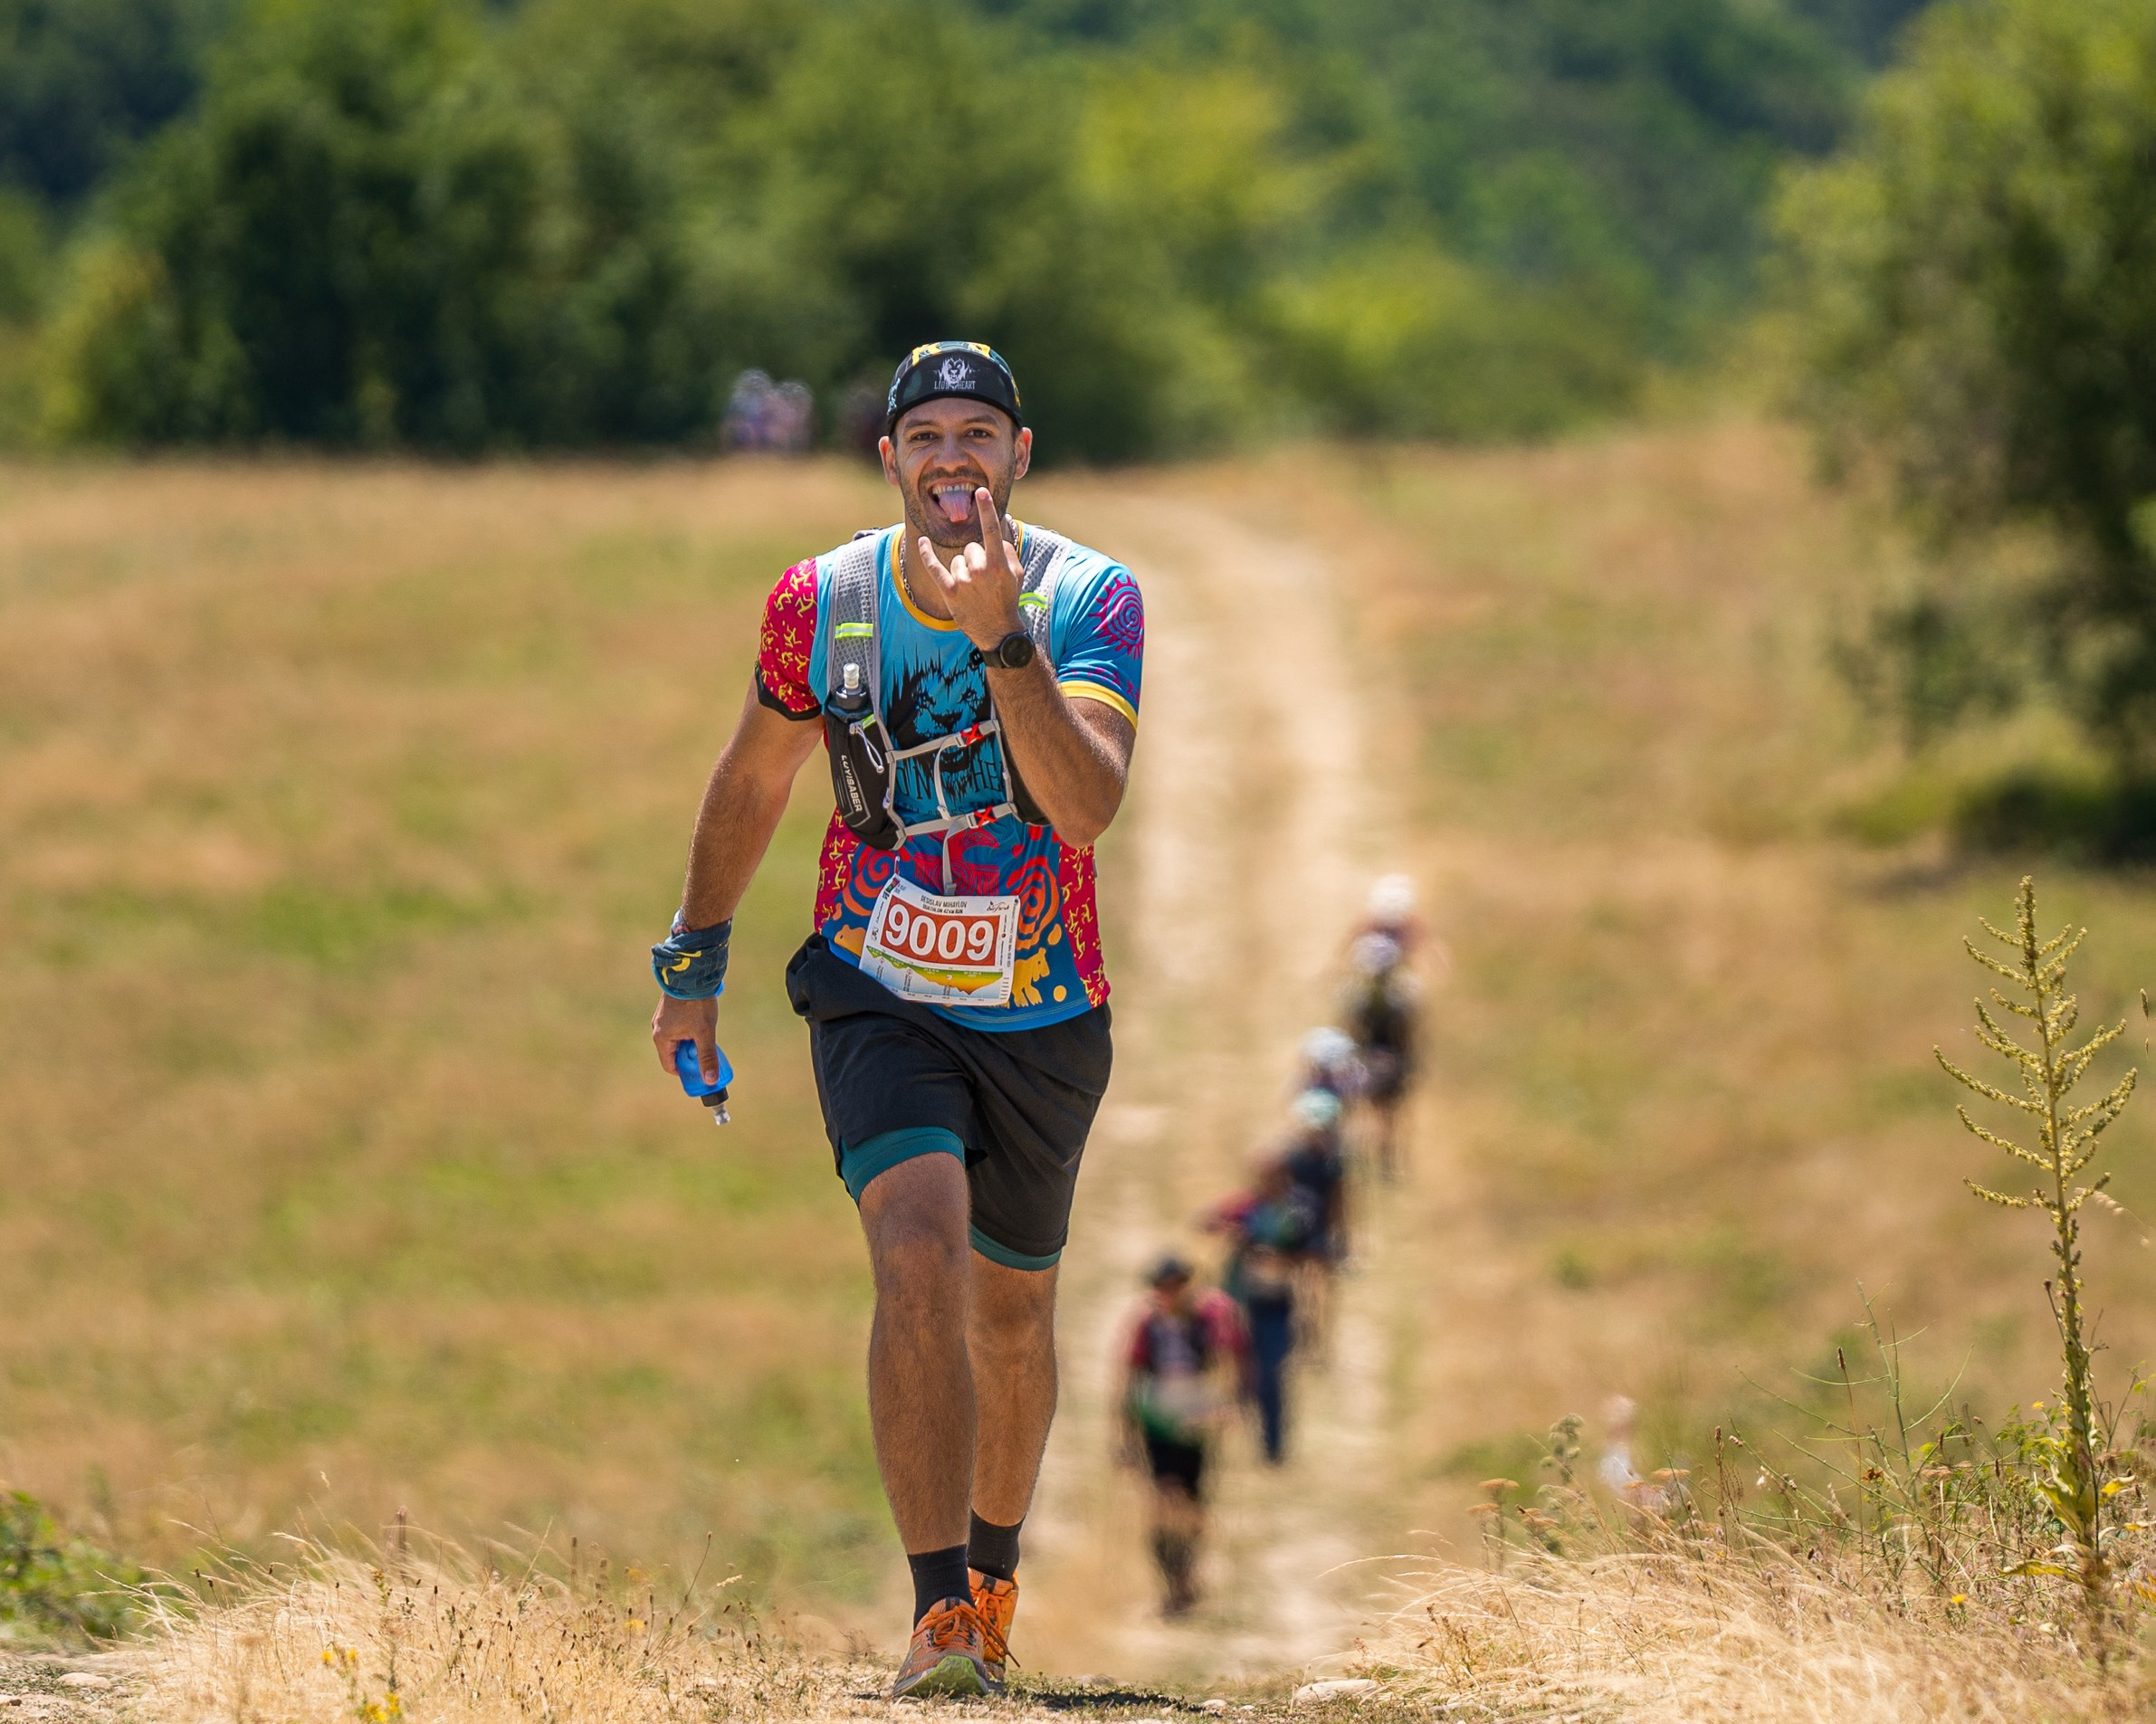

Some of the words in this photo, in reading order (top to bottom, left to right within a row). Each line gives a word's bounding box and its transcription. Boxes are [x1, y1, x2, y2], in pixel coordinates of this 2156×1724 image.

[958, 380, 977, 390] HEART
[841, 755, 863, 813] LUYISABER
[921, 894, 942, 908] DESISLAV
[942, 900, 968, 909] MIHAYLOV
[885, 903, 994, 961] 9009
